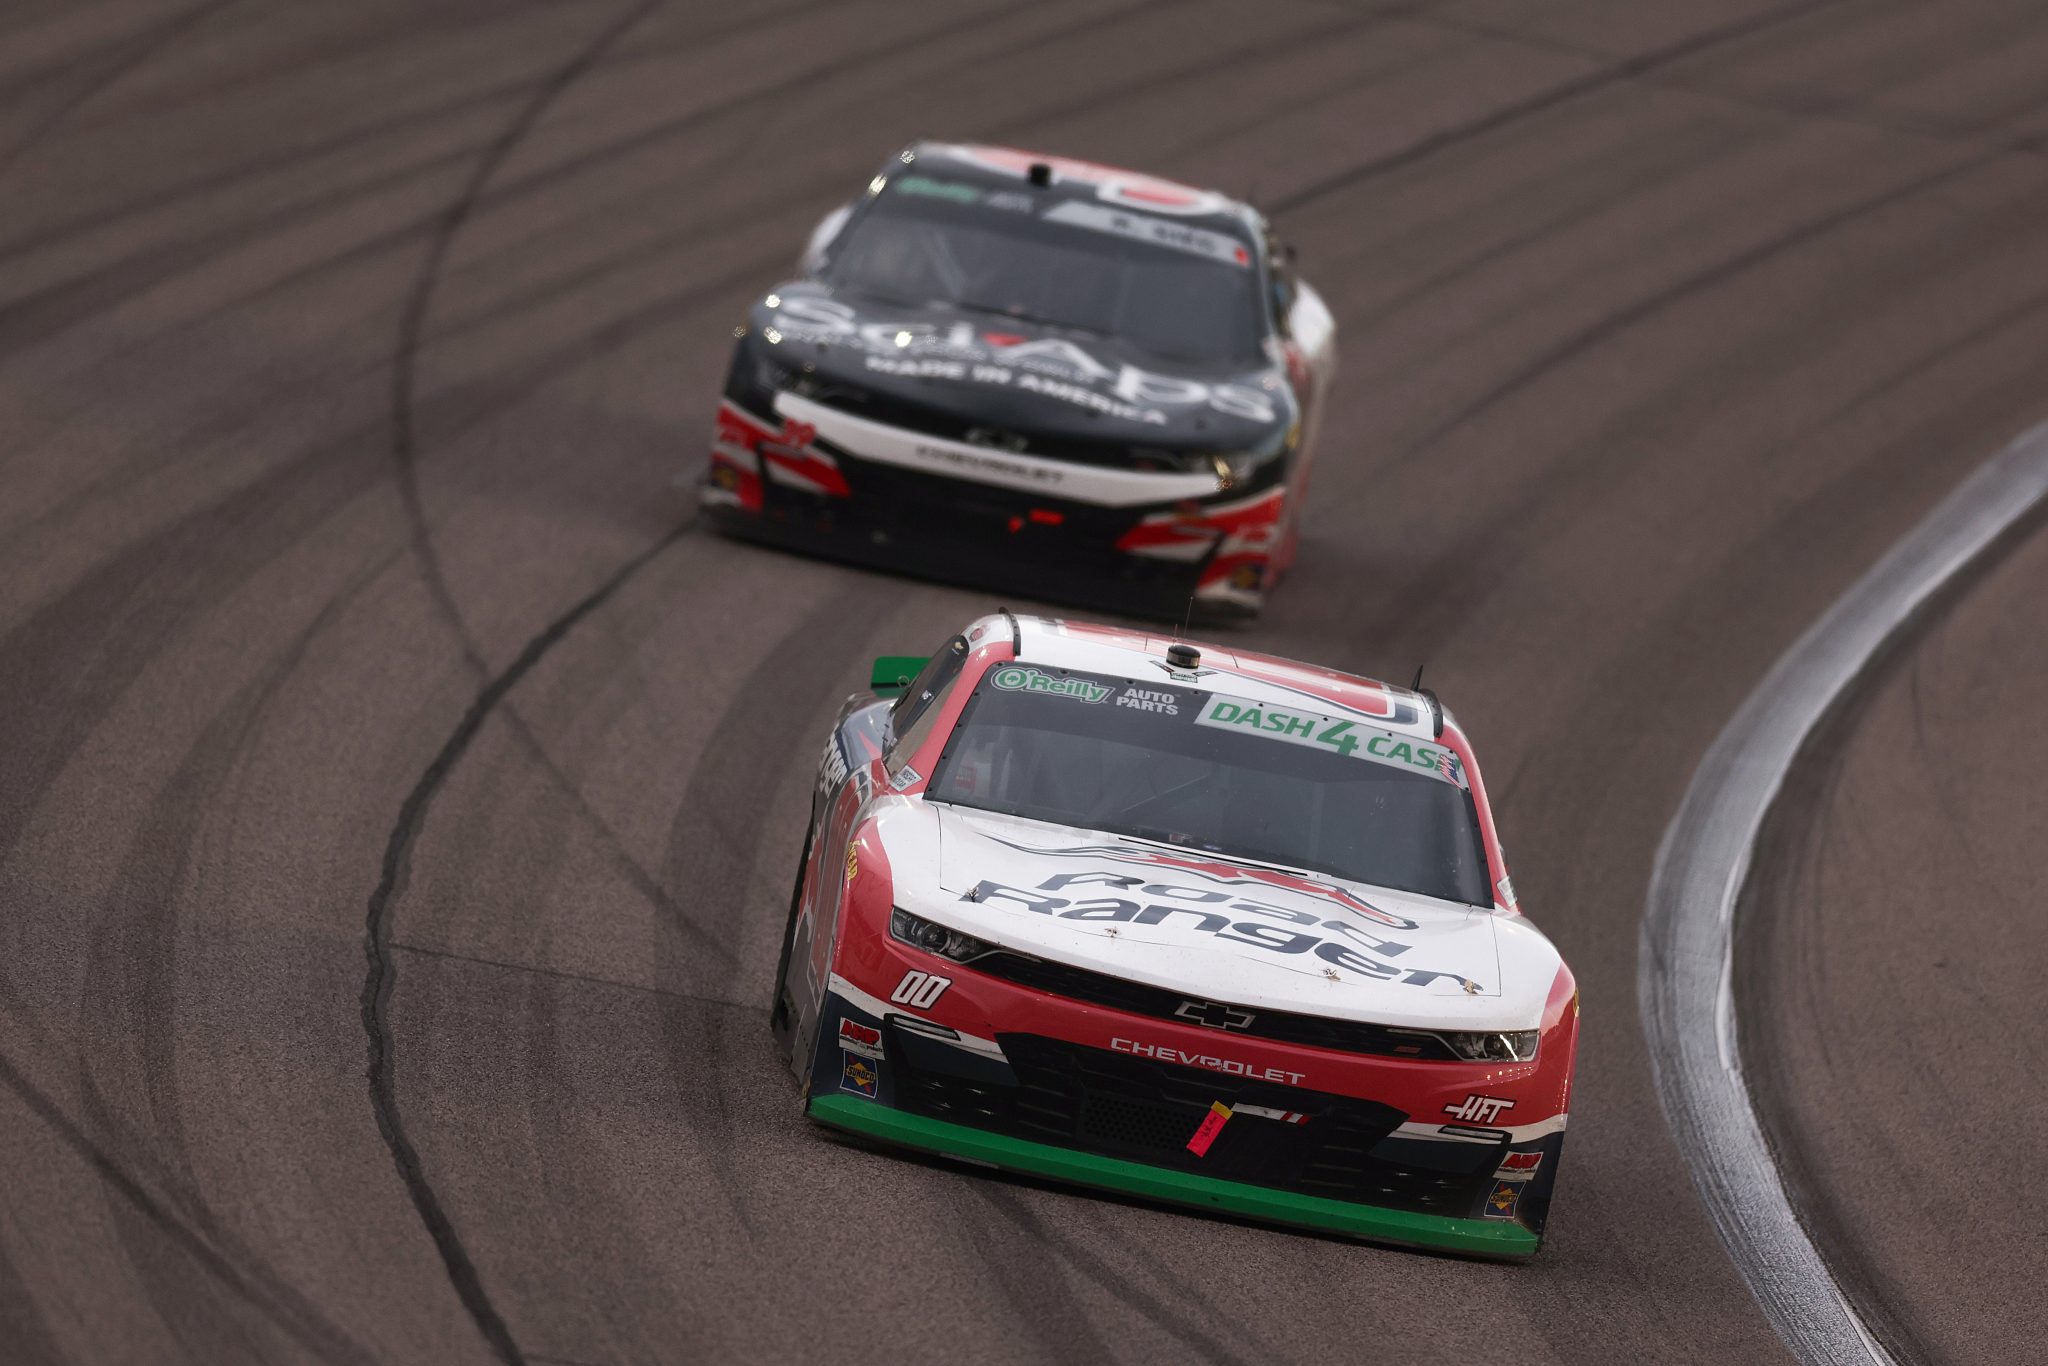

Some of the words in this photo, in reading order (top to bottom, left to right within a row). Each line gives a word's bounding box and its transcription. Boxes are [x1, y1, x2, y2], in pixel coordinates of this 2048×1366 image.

[864, 355, 966, 378] MADE
[972, 364, 1011, 385] IN
[1017, 373, 1168, 426] AMERICA
[993, 668, 1107, 702] O'Reilly
[1116, 696, 1179, 716] PARTS
[1123, 688, 1175, 703] AUTO
[1208, 702, 1316, 738] DASH
[1316, 721, 1360, 756] 4
[958, 879, 1484, 991] Ranger
[1035, 871, 1414, 957] Road
[890, 969, 952, 1010] 00
[846, 1065, 876, 1083] SUNOCO
[1110, 1036, 1306, 1085] CHEVROLET
